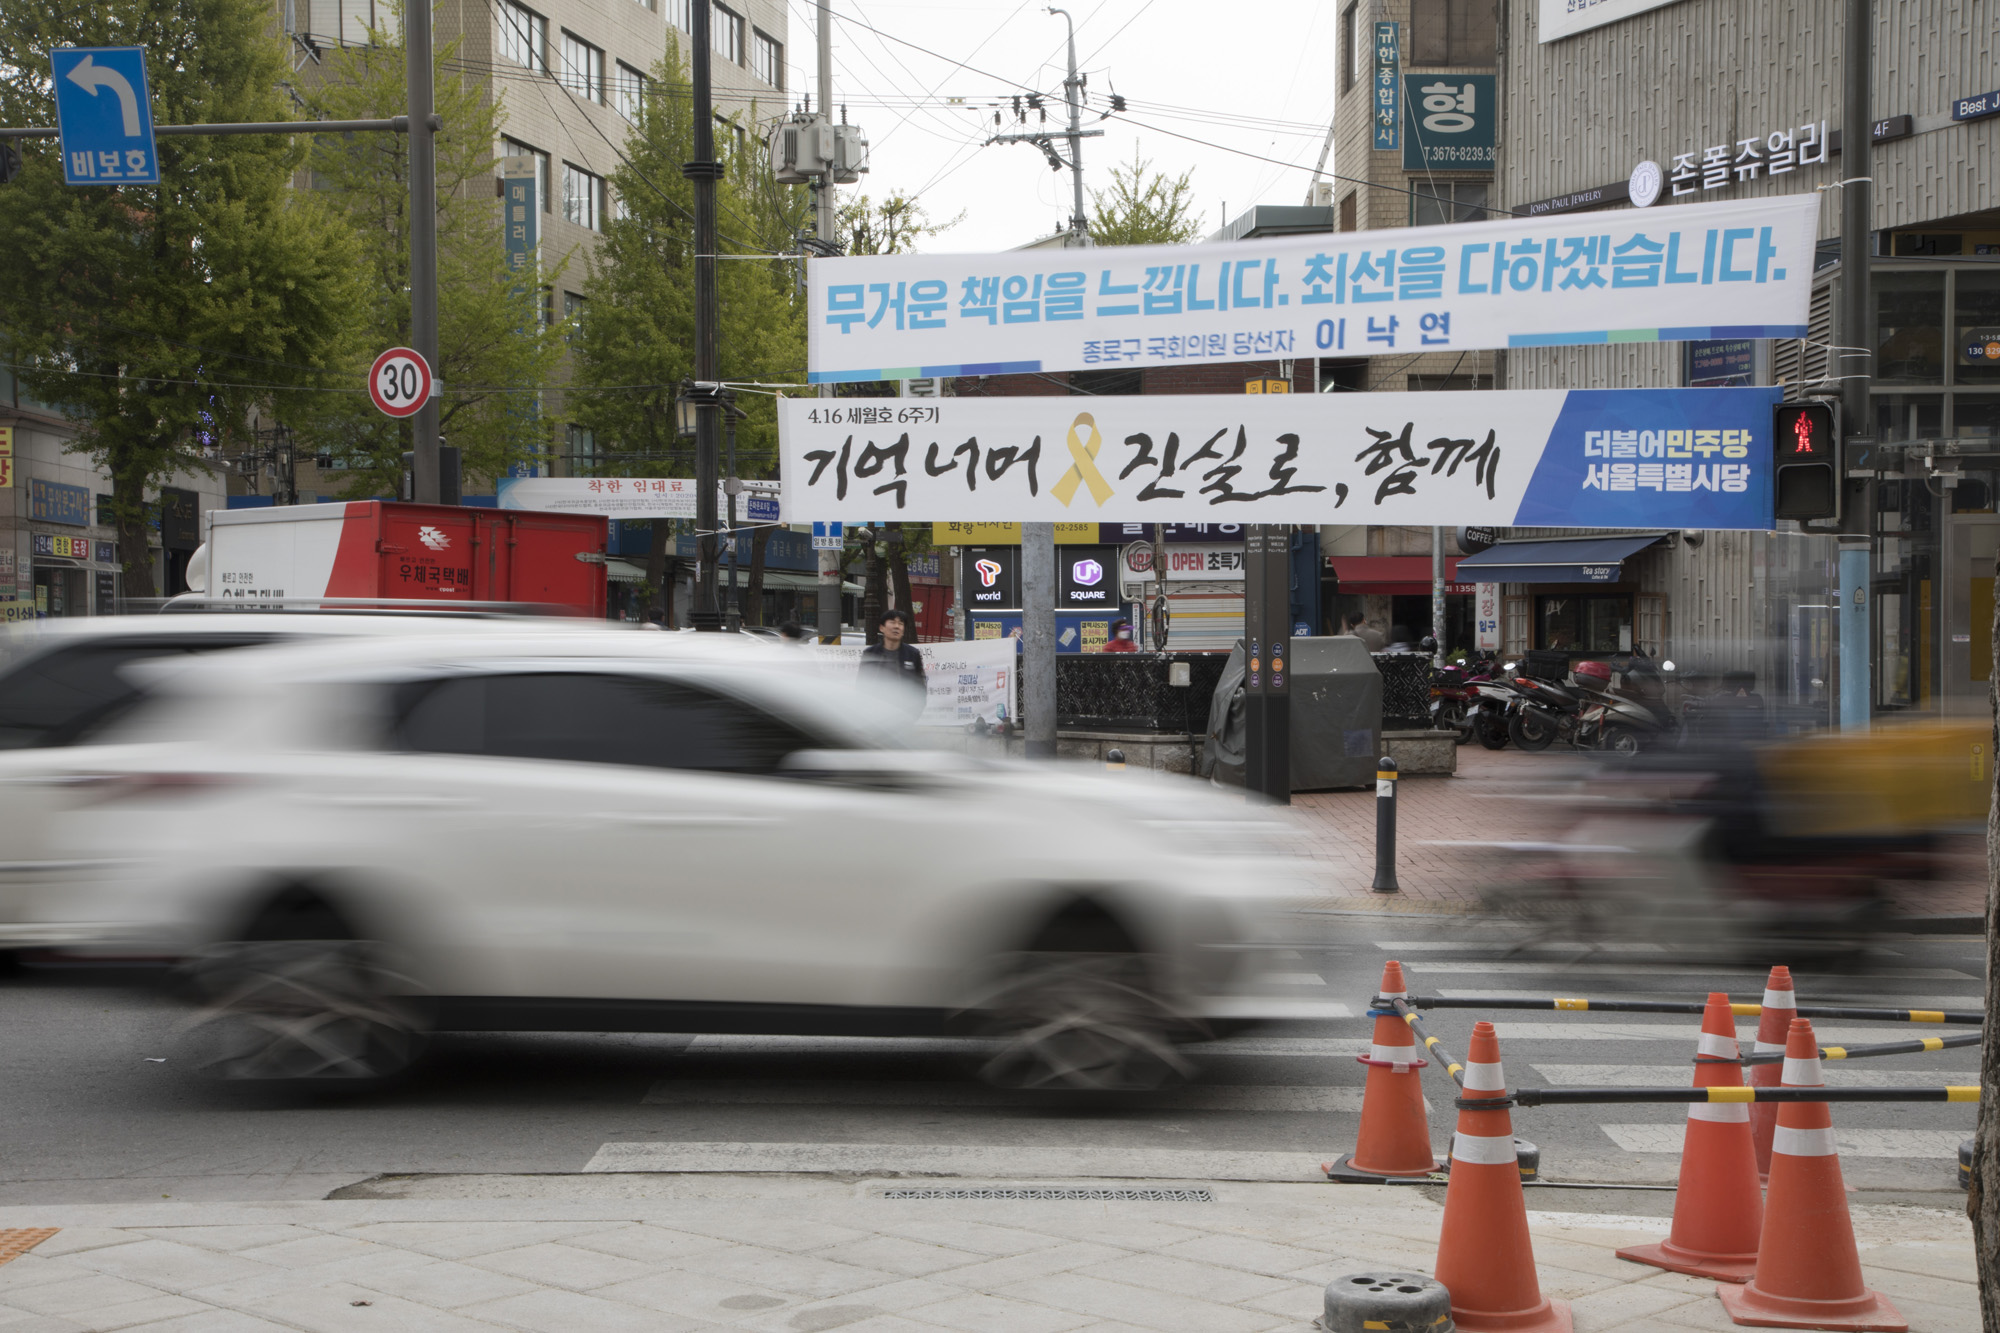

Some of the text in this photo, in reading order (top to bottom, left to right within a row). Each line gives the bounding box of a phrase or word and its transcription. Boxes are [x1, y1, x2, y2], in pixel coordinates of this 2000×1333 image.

[1378, 26, 1395, 146] 규한종합상사
[1421, 81, 1475, 133] 형
[1960, 97, 1987, 116] Best
[1874, 121, 1889, 137] 4F
[71, 149, 150, 179] 비보호
[1670, 120, 1828, 197] 존폴쥬얼리
[1530, 189, 1603, 216] JOHN PAUL JEWELRY
[826, 226, 1787, 334] 무거운 책임을 느낍니다. 최선을 다하겠습니다.
[1082, 338, 1142, 364] 종로구
[1146, 333, 1228, 361] 국회의원
[1233, 329, 1296, 356] 당선자
[383, 364, 416, 401] 30
[807, 406, 940, 425] 4.16 세월호 6주기
[1584, 429, 1752, 459] 더불어민주당
[802, 432, 909, 509] 기억
[924, 434, 1042, 497] 너머
[1355, 422, 1501, 505] 함께
[587, 479, 623, 494] 착한
[633, 479, 685, 493] 임대료
[1582, 463, 1751, 493] 서울특별시당
[814, 537, 842, 547] 일방통행
[1466, 530, 1493, 545] COFFEE
[74, 540, 87, 556] 도장
[1172, 552, 1204, 571] OPEN
[1208, 551, 1245, 571] 초특가
[222, 573, 253, 584] 빠르고 안전한
[400, 564, 469, 586] 우체국택배
[1583, 567, 1610, 577] Tea story
[976, 591, 1001, 600] world
[1070, 591, 1106, 600] SQUARE
[1294, 628, 1308, 636] ADT
[1479, 620, 1496, 632] 입구
